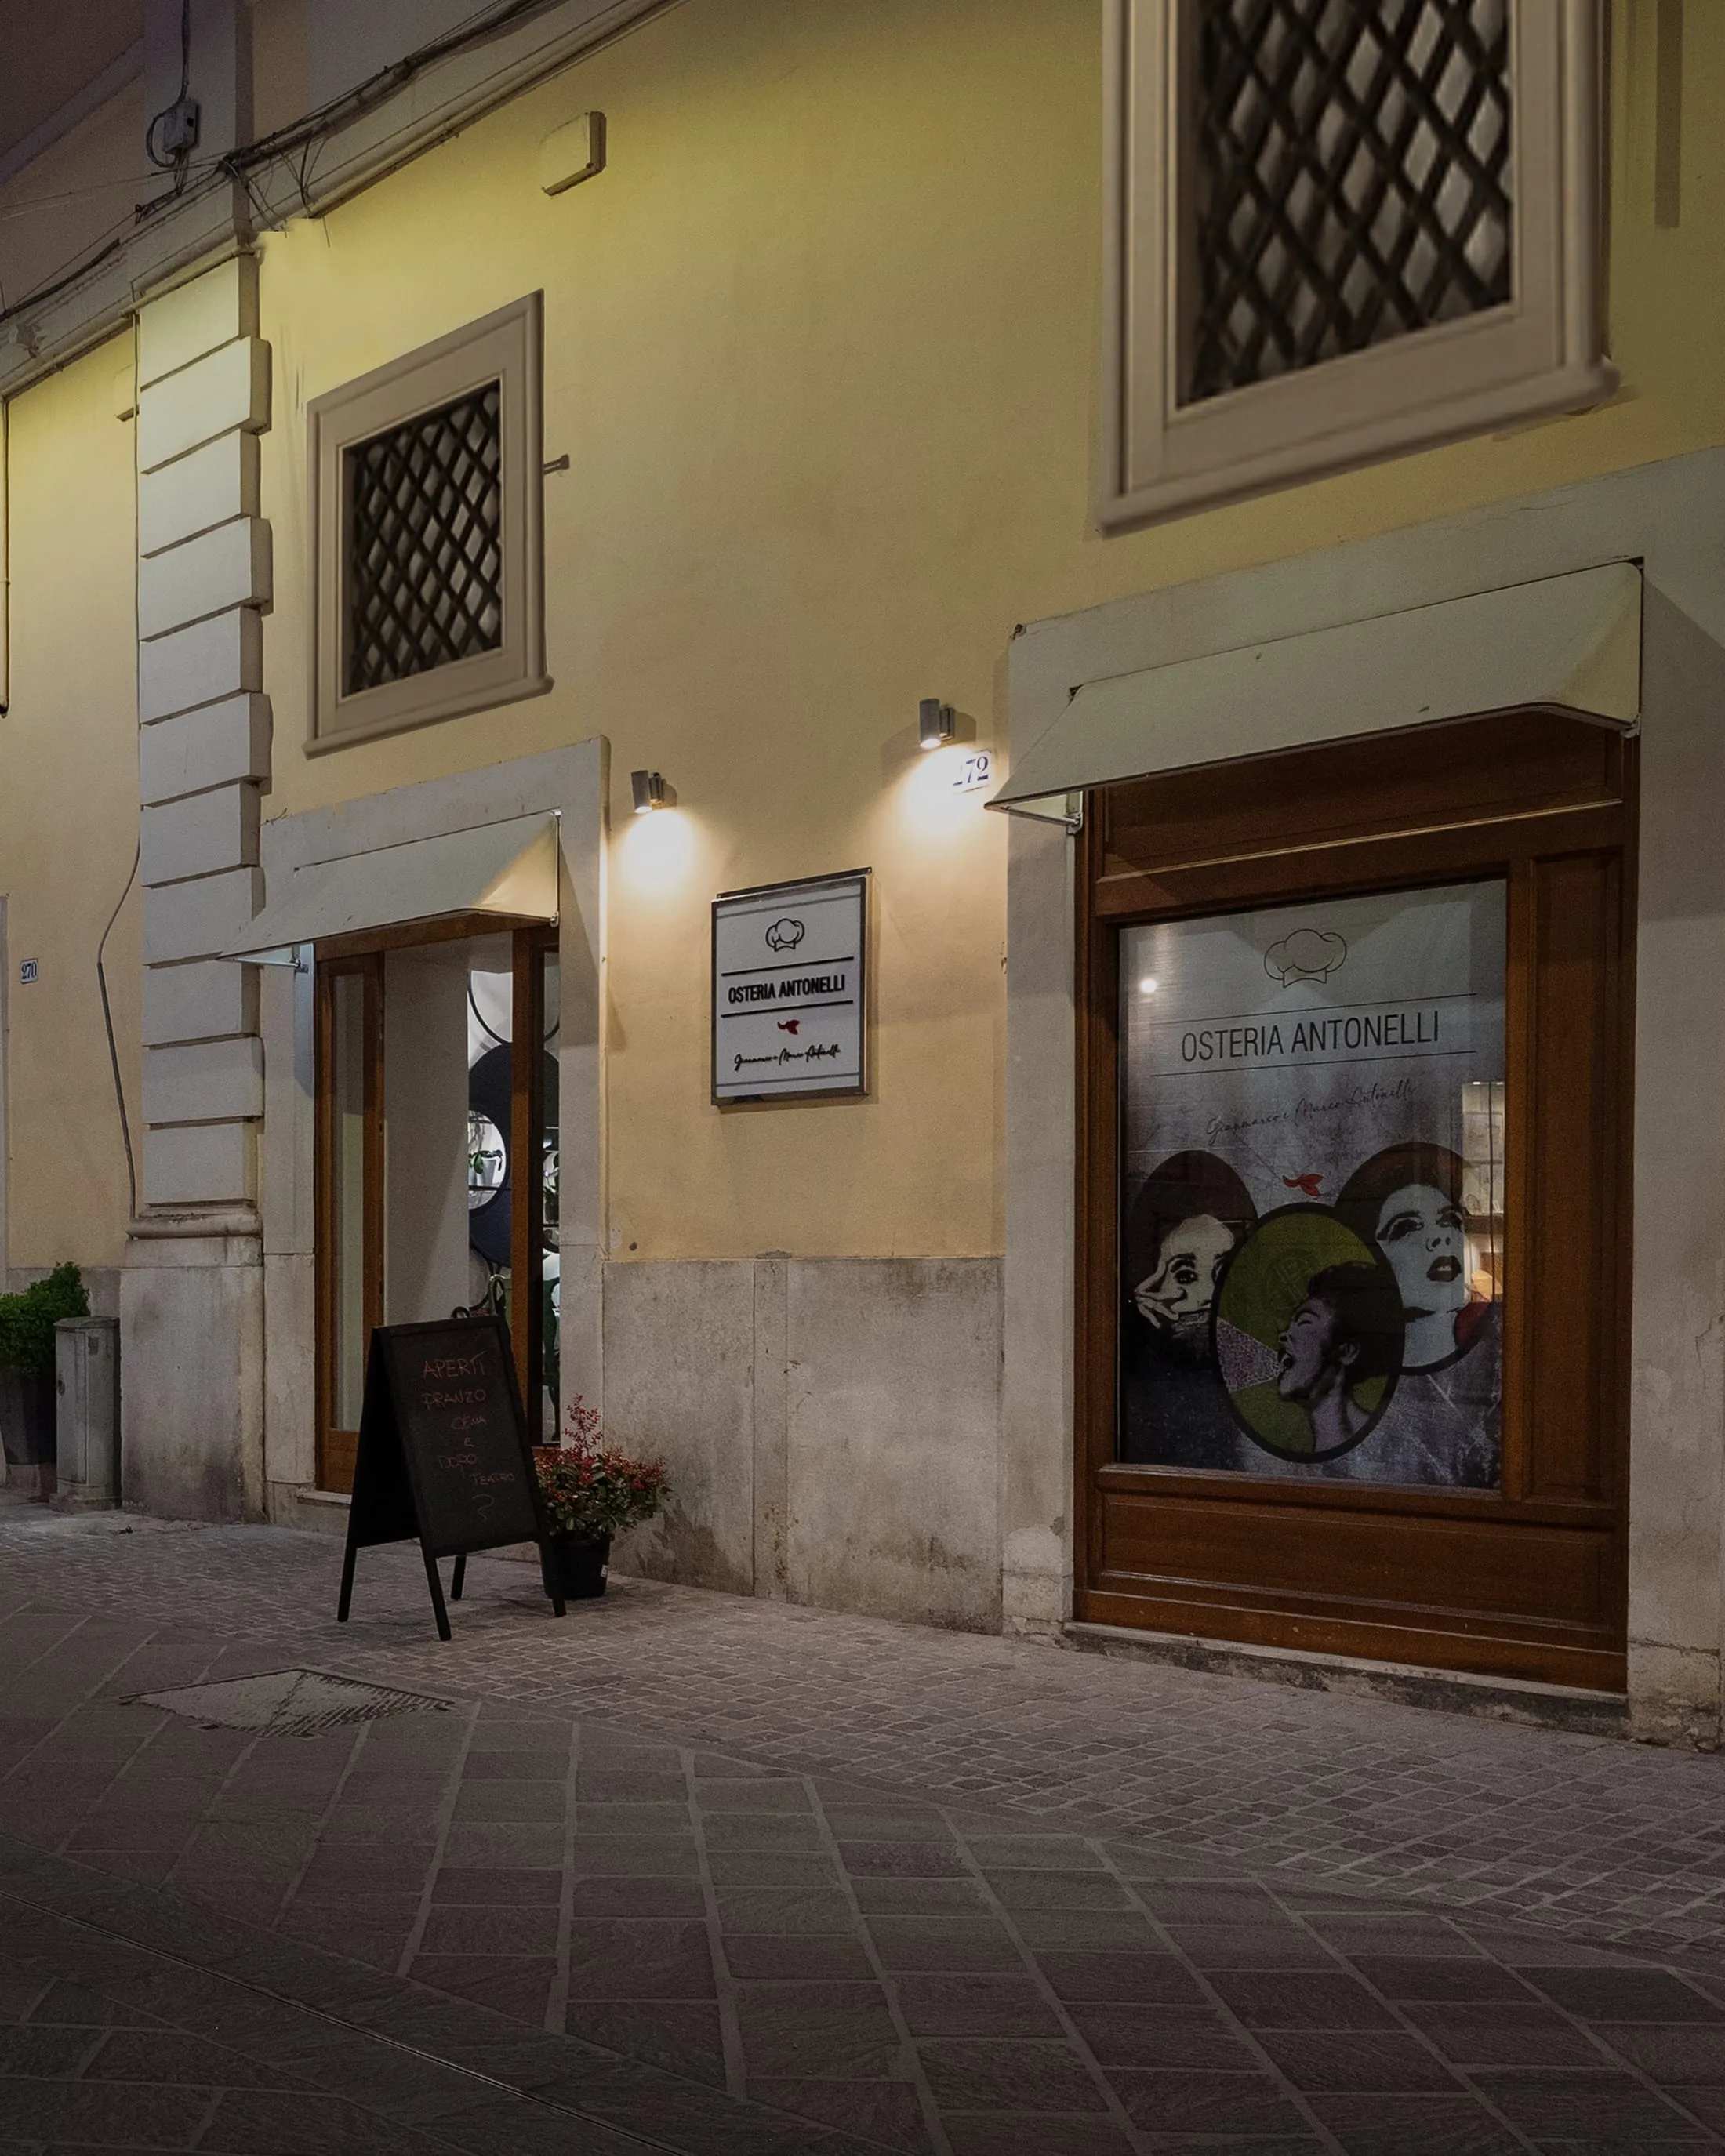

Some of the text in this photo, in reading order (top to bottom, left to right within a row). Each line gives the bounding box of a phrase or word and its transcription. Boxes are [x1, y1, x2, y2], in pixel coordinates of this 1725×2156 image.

[952, 756, 990, 786] 72
[21, 961, 37, 980] 270
[728, 975, 845, 1004] OSTERIA ANTONELLI
[1181, 1010, 1440, 1062] OSTERIA ANTONELLI
[423, 1351, 487, 1379] APERTI
[421, 1388, 487, 1410] PRANZO
